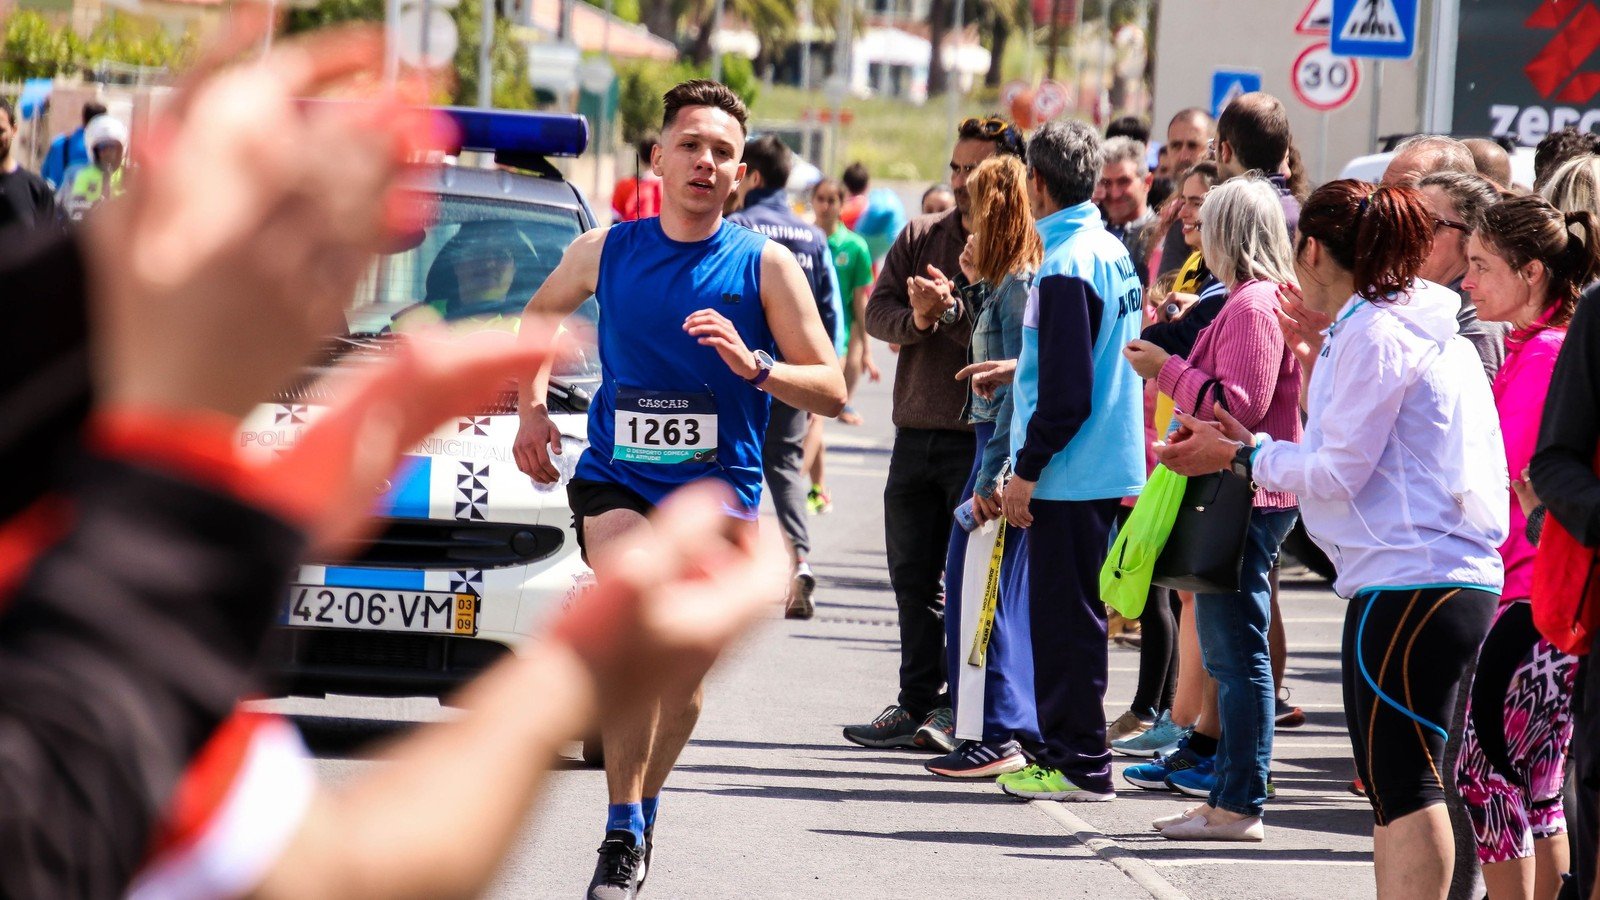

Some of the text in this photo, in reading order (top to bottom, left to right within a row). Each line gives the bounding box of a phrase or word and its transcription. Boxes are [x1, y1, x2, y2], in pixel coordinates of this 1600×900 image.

[1303, 62, 1347, 89] 30
[752, 224, 813, 242] ATLETISMO
[638, 398, 689, 409] CASCAIS
[628, 417, 701, 446] 1263
[416, 438, 514, 463] NICIPAL
[632, 448, 662, 456] DESPORTO
[458, 599, 472, 610] 03
[457, 618, 471, 630] 09
